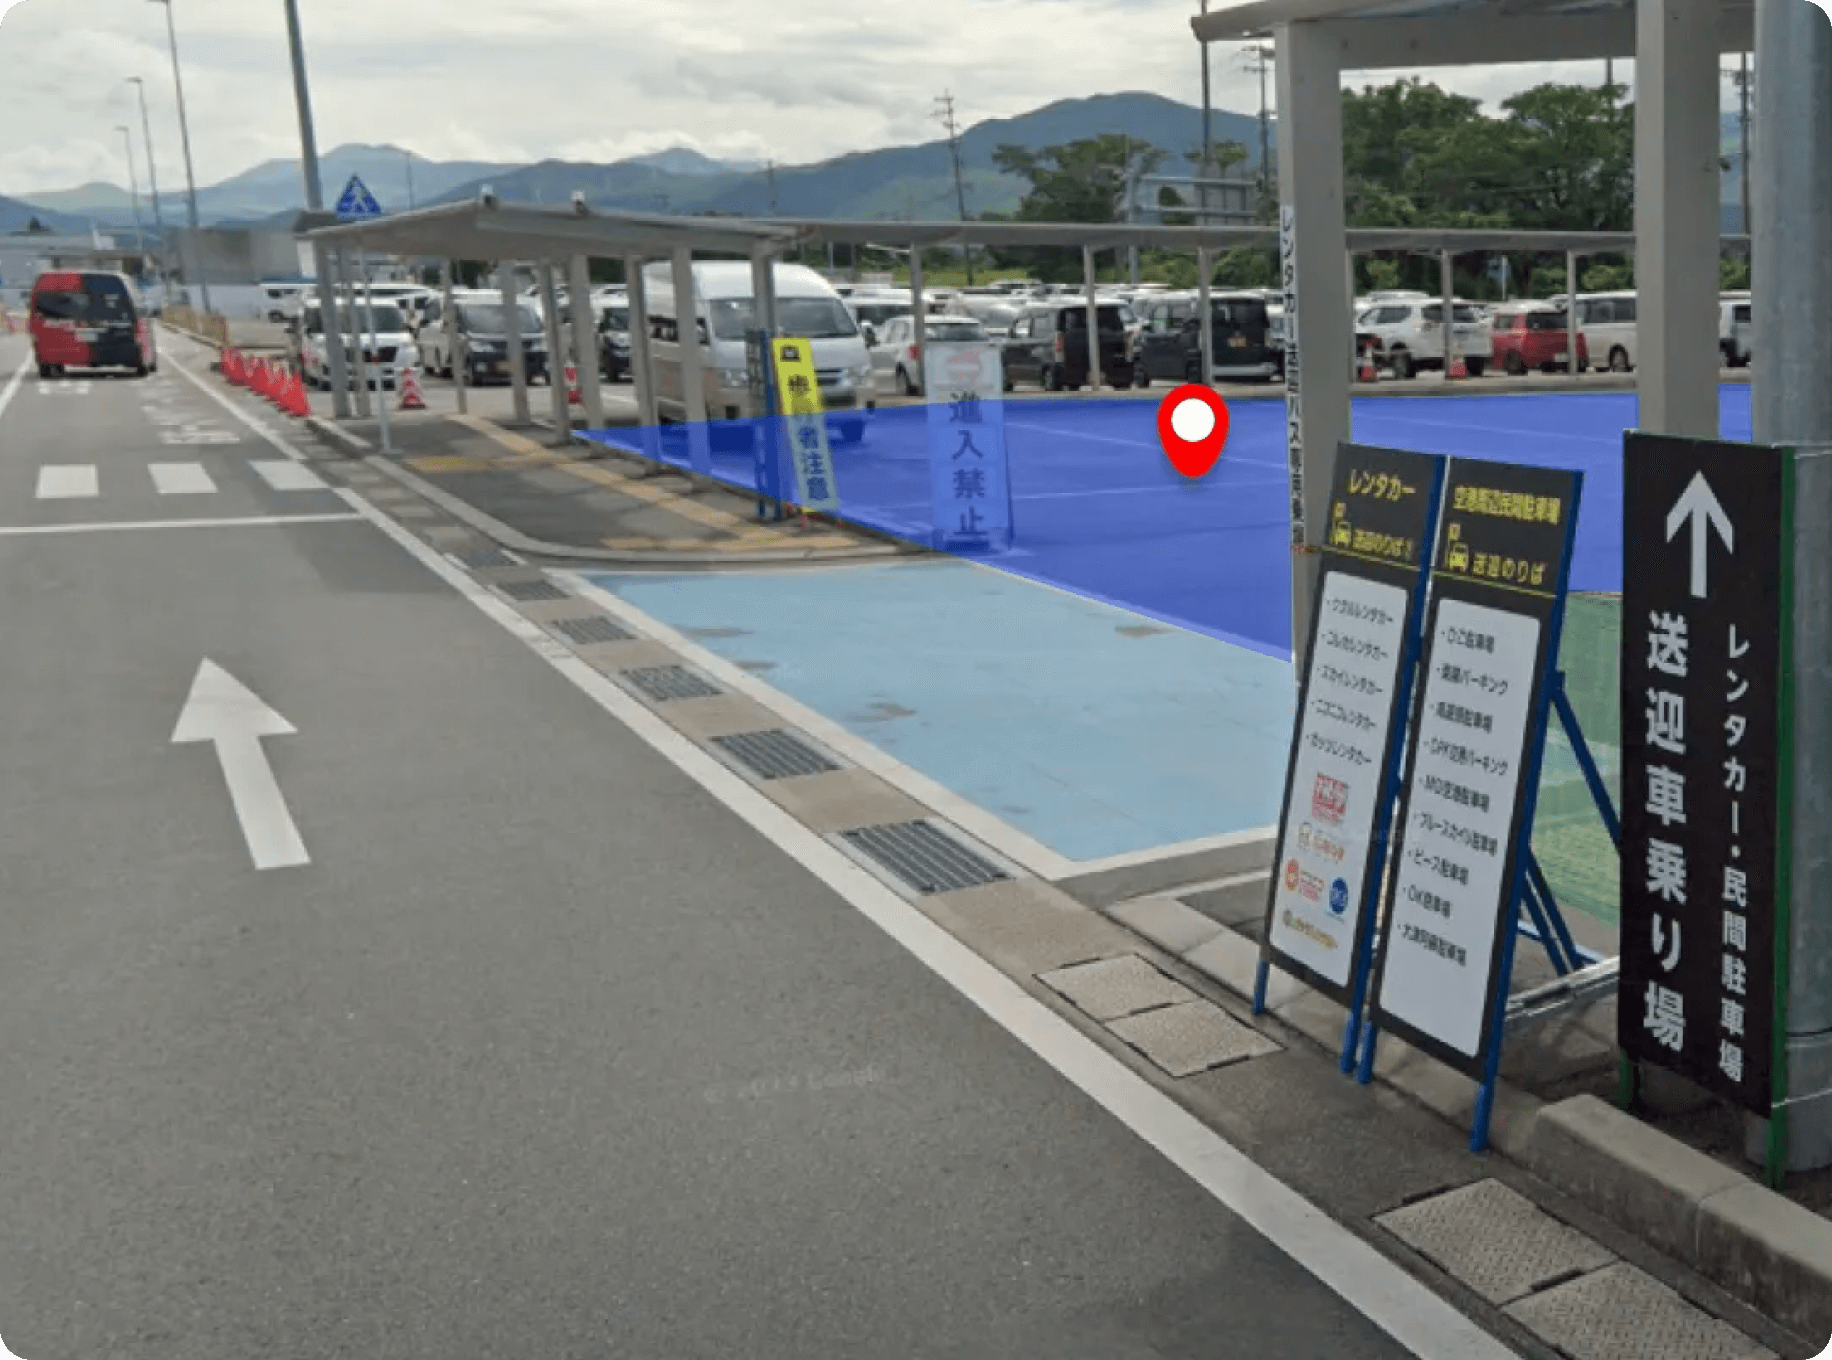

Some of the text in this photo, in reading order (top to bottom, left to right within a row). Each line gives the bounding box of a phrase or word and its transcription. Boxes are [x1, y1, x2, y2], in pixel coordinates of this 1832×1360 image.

[949, 390, 988, 536] 進入禁止
[1347, 468, 1416, 502] レンタカー
[1471, 553, 1548, 586] 送迎のりば
[1644, 610, 1689, 1053] 送迎車乗り場
[1718, 623, 1751, 1083] レンタカー・民間駐車場
